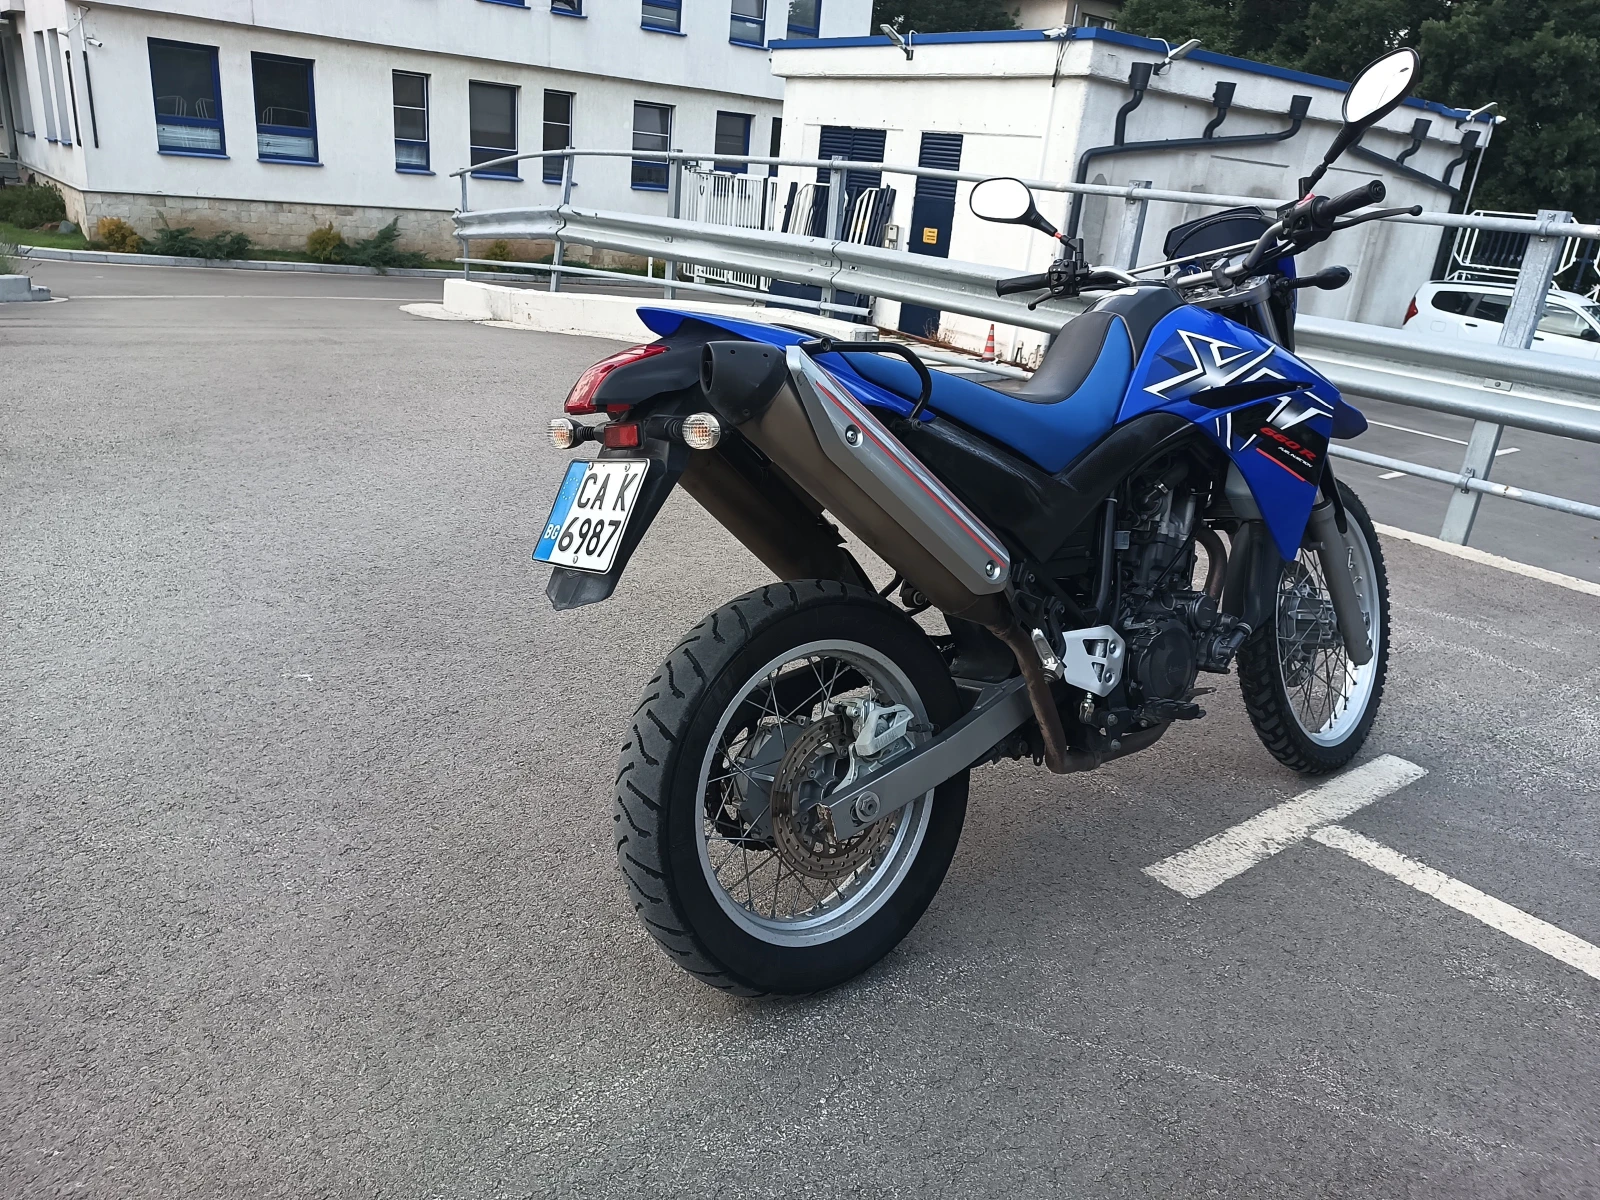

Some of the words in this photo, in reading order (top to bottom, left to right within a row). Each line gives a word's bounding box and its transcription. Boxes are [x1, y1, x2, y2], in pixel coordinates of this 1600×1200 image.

[577, 473, 611, 509] CA
[612, 473, 638, 511] K
[544, 523, 561, 540] BG
[557, 517, 621, 557] 6987
